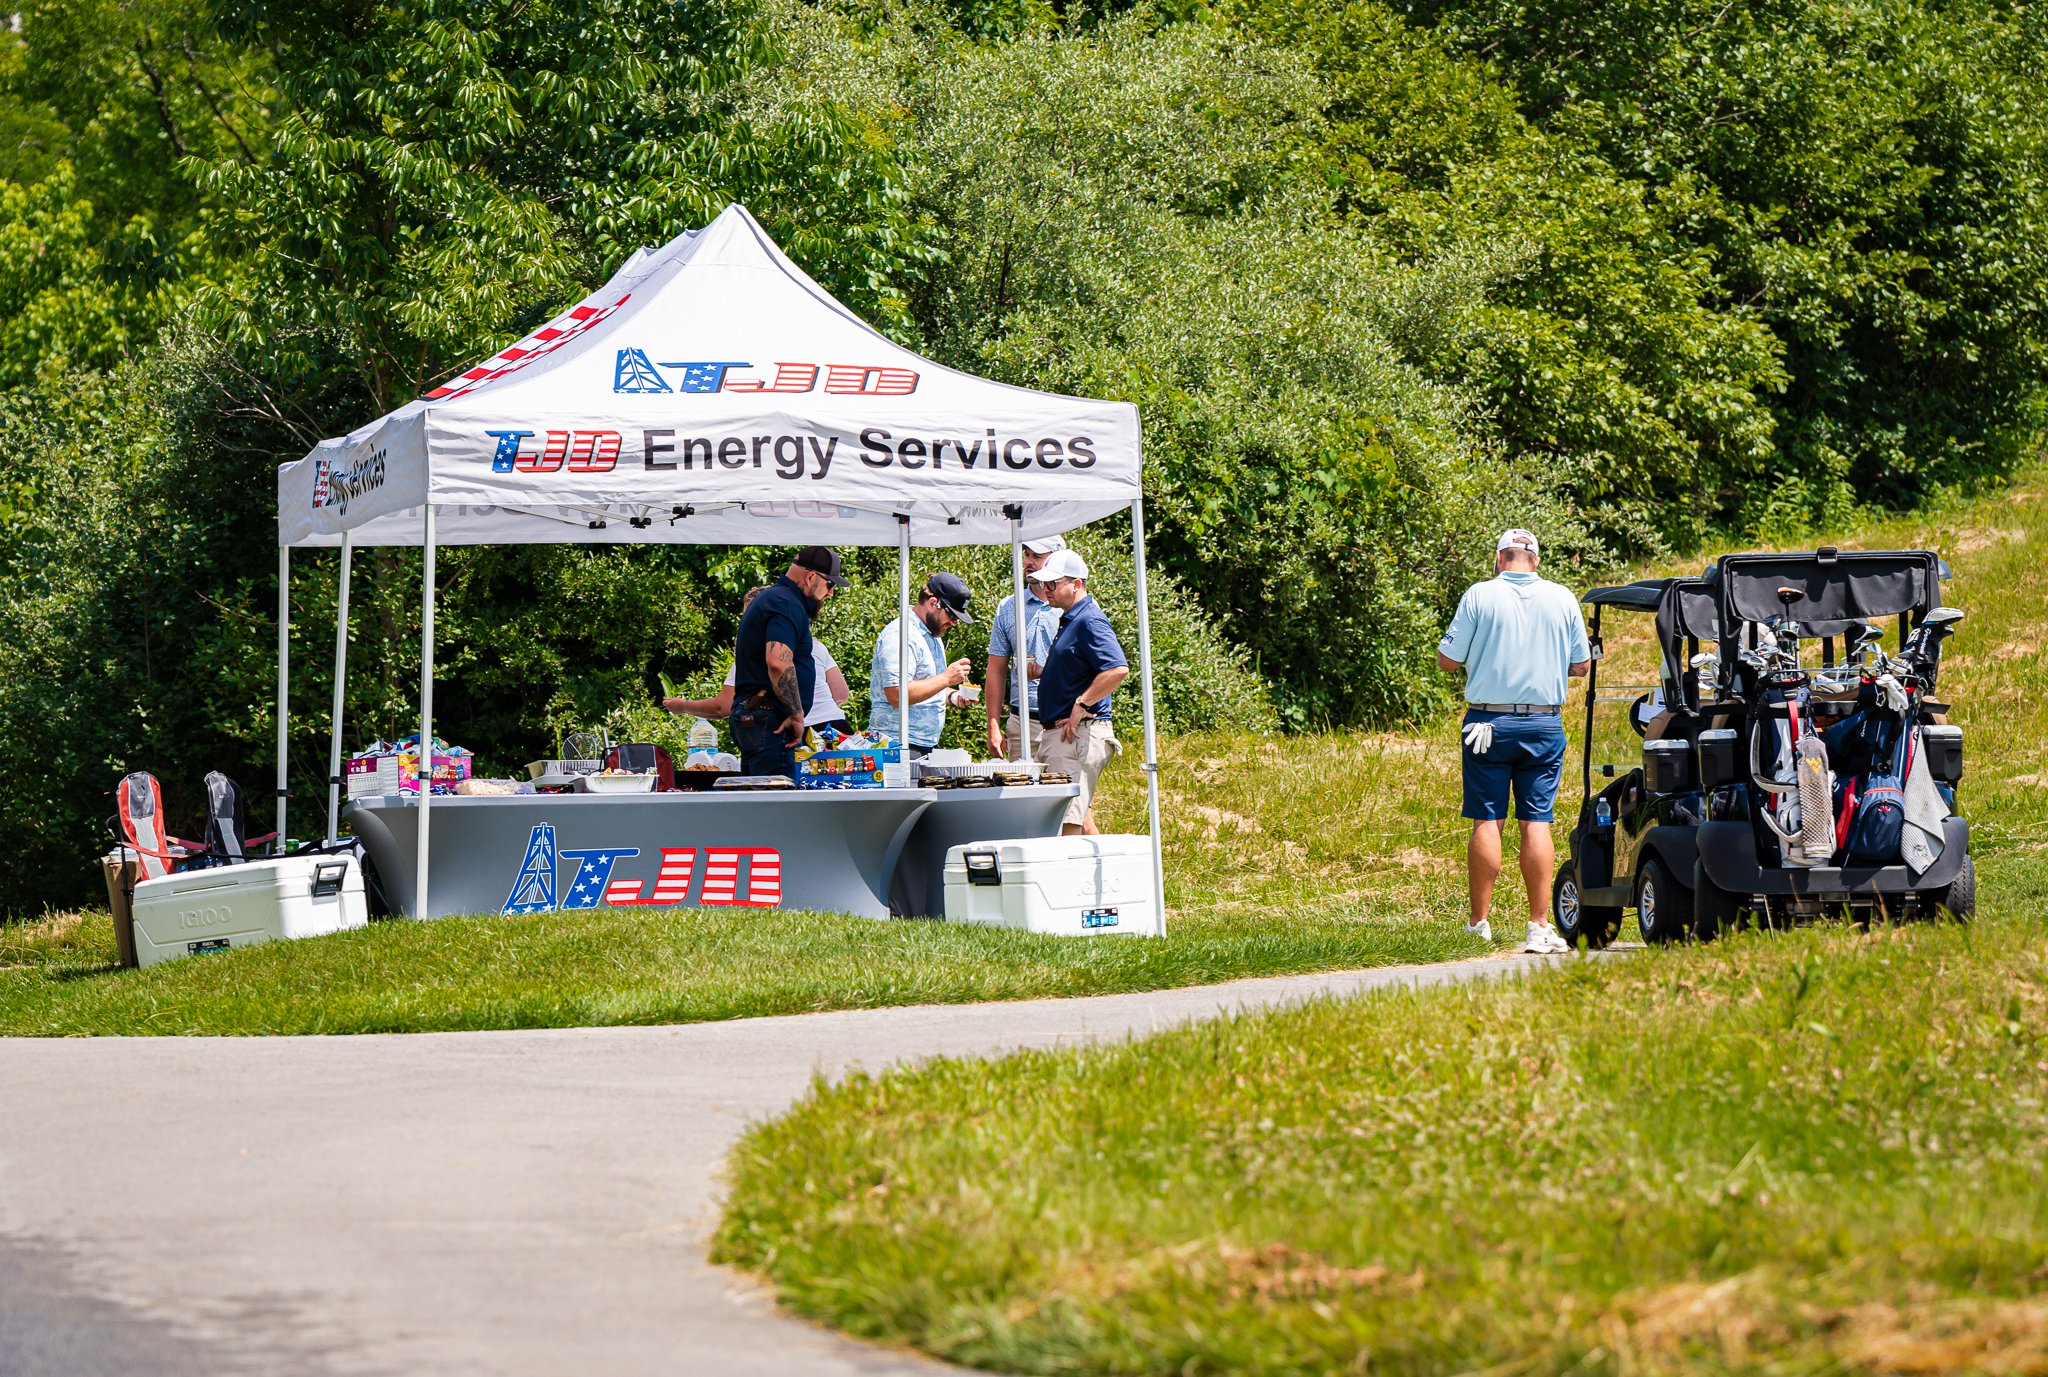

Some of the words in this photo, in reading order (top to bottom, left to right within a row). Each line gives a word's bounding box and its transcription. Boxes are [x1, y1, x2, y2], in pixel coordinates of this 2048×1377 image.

[485, 430, 623, 474] TJD
[644, 429, 838, 480] Energy
[859, 428, 1096, 469] Services
[178, 905, 232, 930] IGLOO
